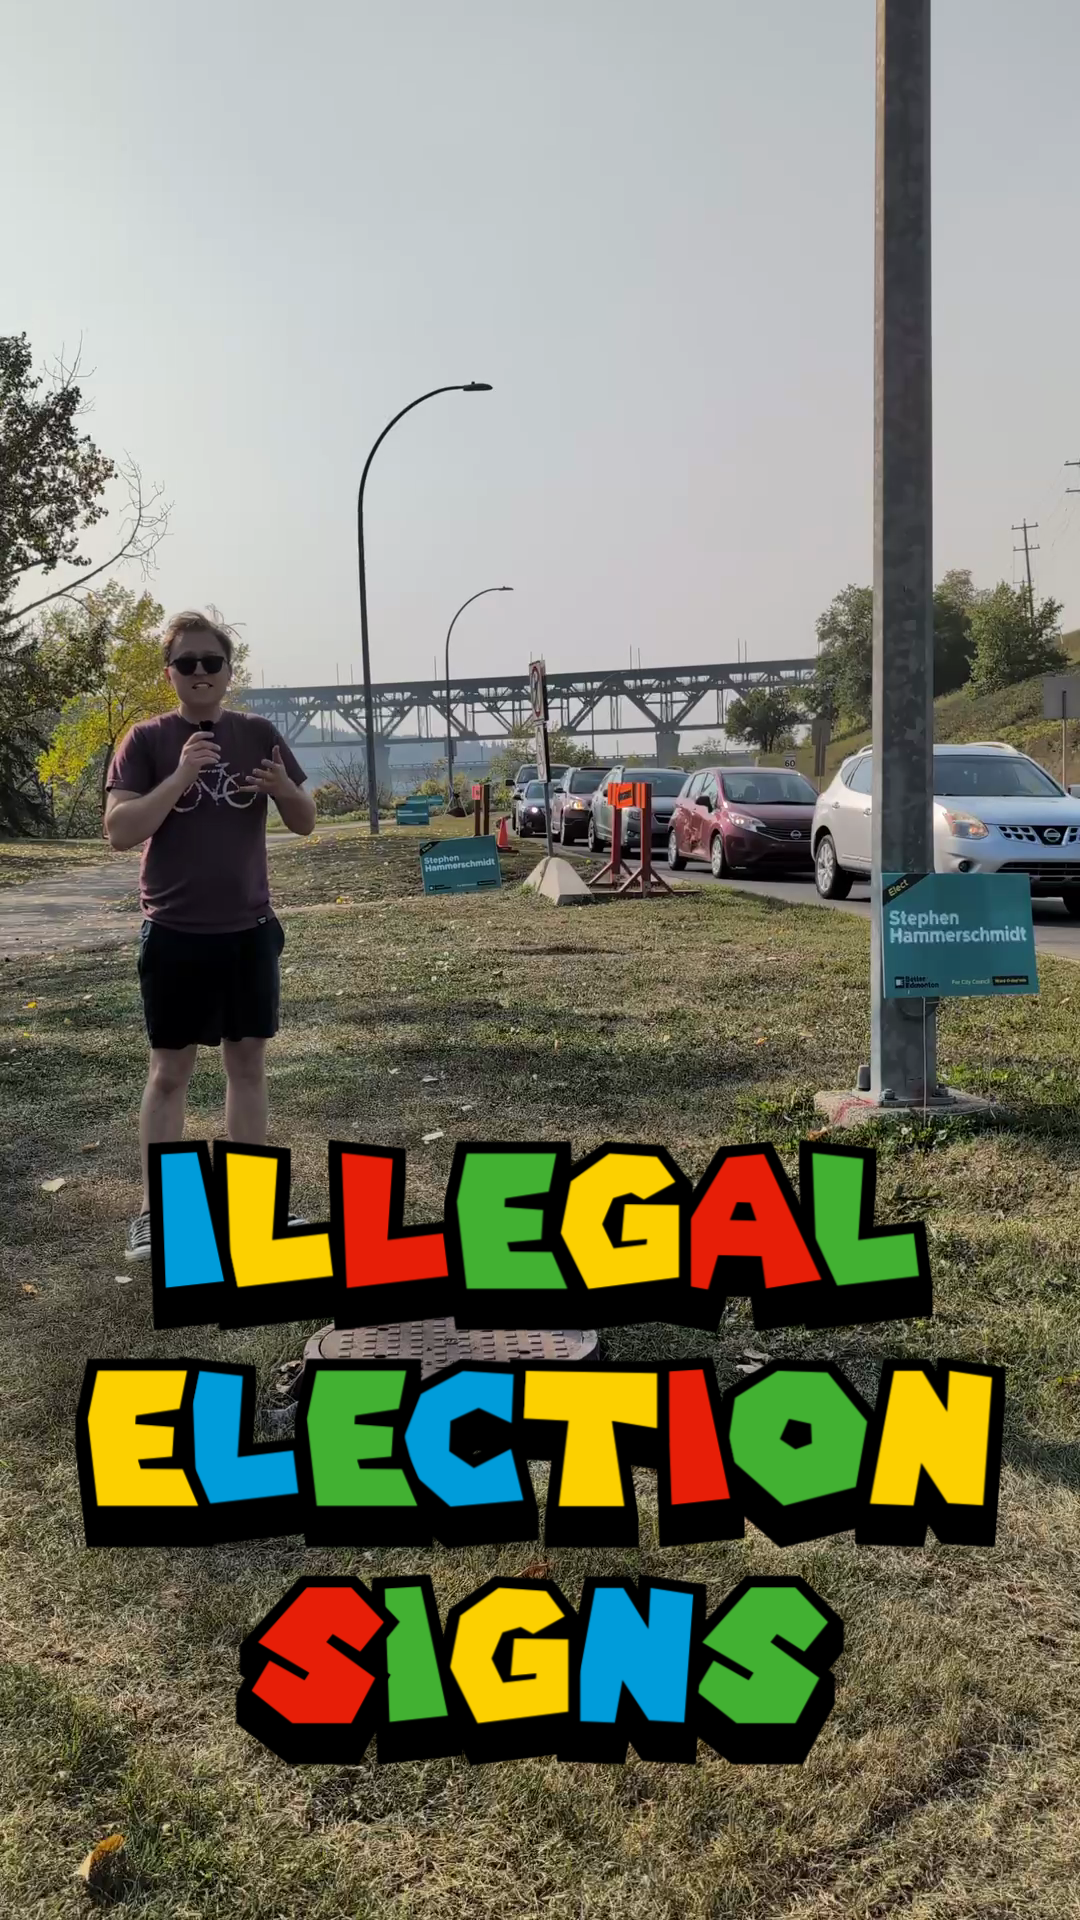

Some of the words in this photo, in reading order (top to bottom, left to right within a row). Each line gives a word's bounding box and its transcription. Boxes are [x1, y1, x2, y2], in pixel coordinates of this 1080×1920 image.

[785, 759, 796, 767] 60
[424, 855, 459, 865] Stephen
[425, 858, 495, 872] Hammerschmidt
[888, 879, 909, 897] Elect
[889, 910, 959, 928] Stephen
[889, 925, 1027, 944] Hammerschmidt
[905, 981, 939, 989] Edmonton
